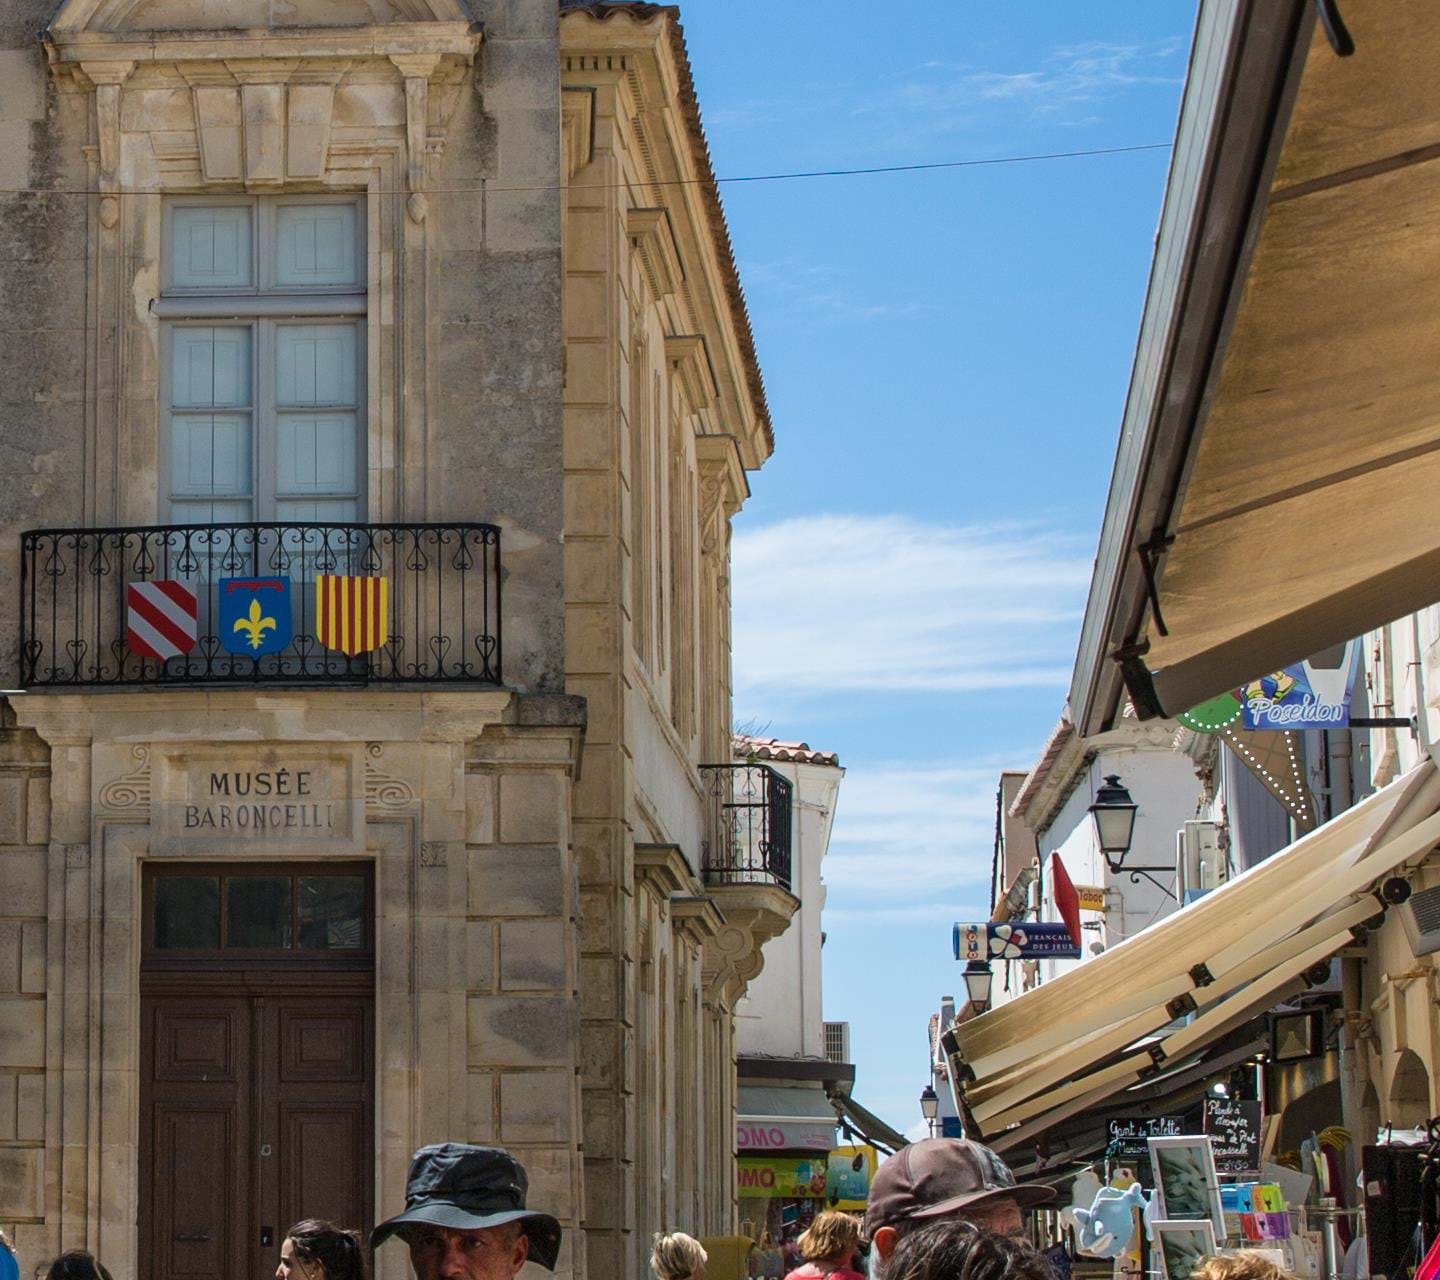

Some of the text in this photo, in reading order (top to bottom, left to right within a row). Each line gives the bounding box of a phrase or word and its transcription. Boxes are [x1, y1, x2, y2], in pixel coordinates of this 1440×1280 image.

[1246, 694, 1344, 726] Poseidon
[209, 767, 312, 796] MUSÉE
[185, 804, 333, 829] BARONCELLI
[1032, 943, 1050, 951] DES
[737, 1167, 776, 1188] MO
